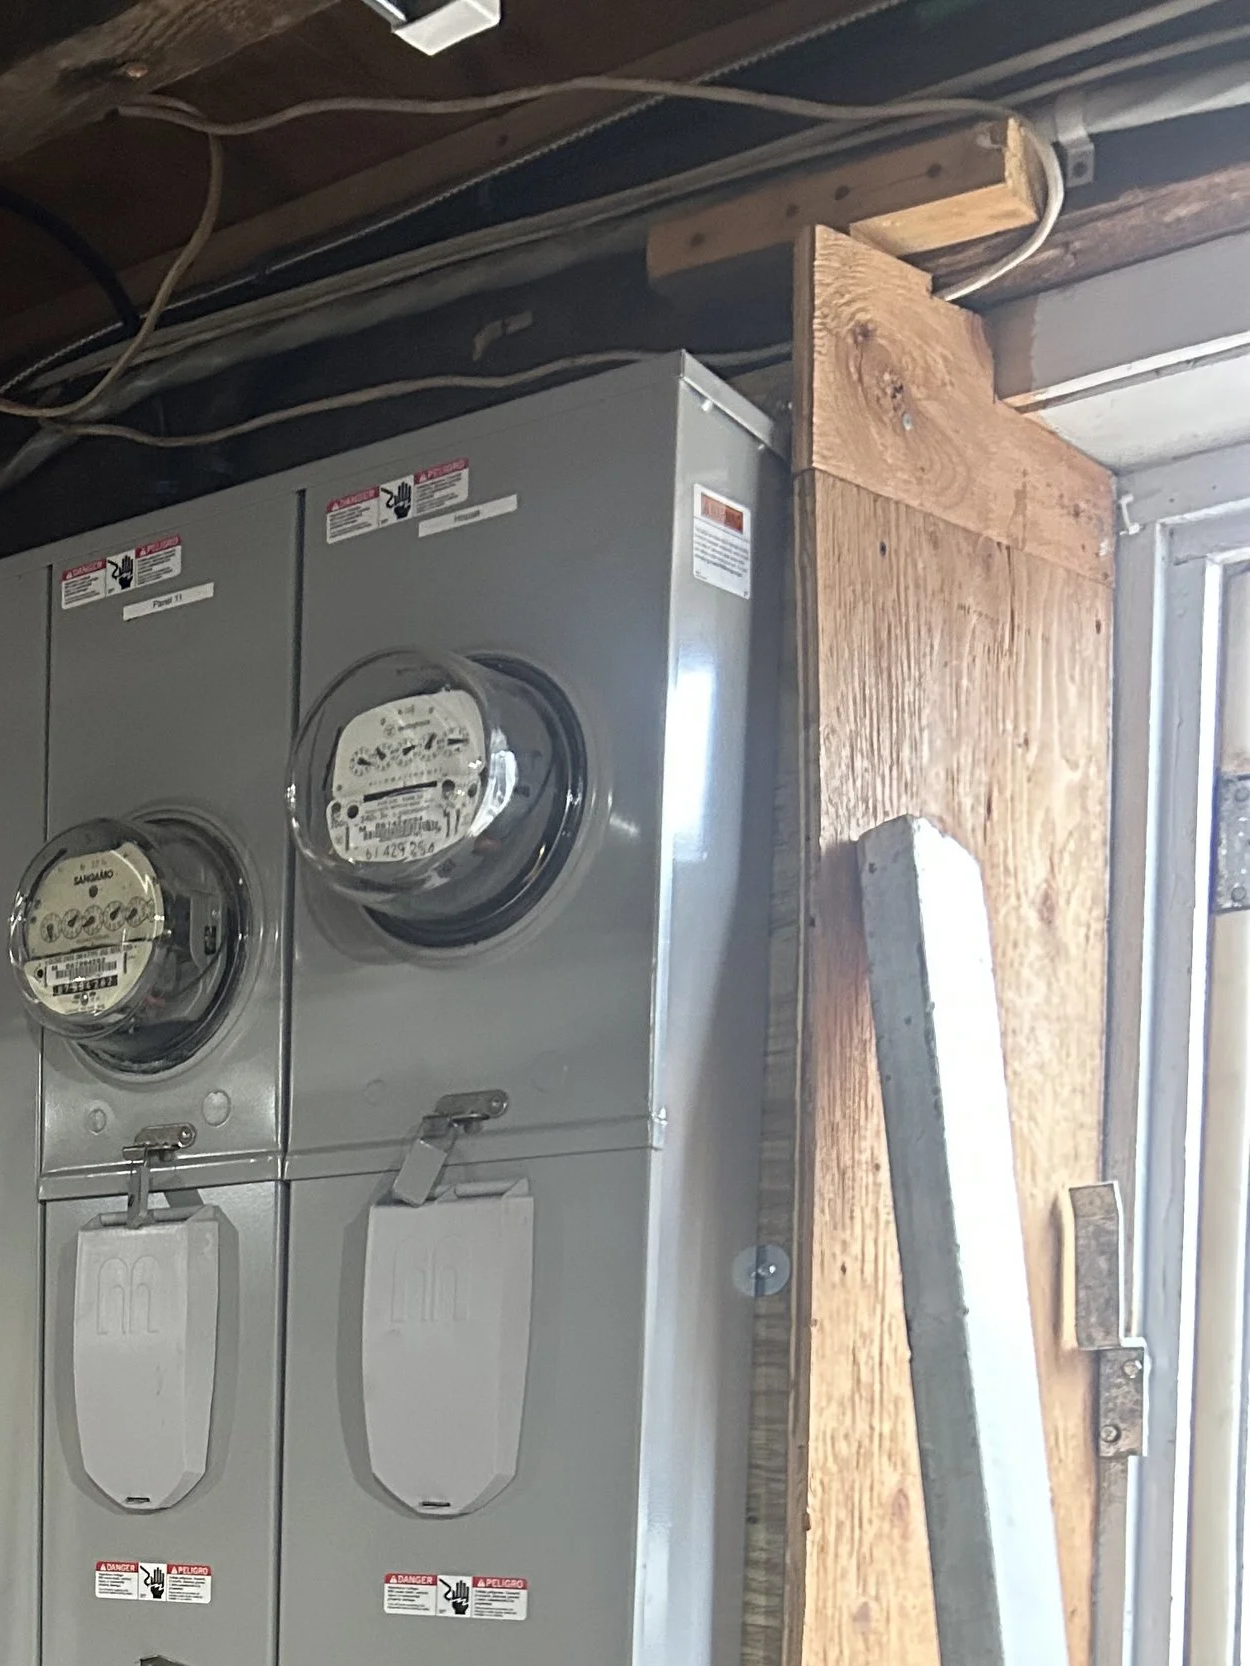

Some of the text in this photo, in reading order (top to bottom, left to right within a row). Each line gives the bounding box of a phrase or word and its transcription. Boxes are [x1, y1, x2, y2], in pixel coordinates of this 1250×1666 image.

[427, 460, 464, 478] PELIGRO
[339, 489, 375, 507] DANGER
[147, 537, 179, 553] PELIGRO
[72, 561, 103, 576] DANGER
[153, 598, 172, 609] Panel
[73, 869, 113, 886] SANGAMO
[106, 1563, 135, 1572] DANGER
[178, 1566, 208, 1575] PELIGRO
[398, 1575, 433, 1585] DANGER
[486, 1579, 524, 1588] PELIGRO
